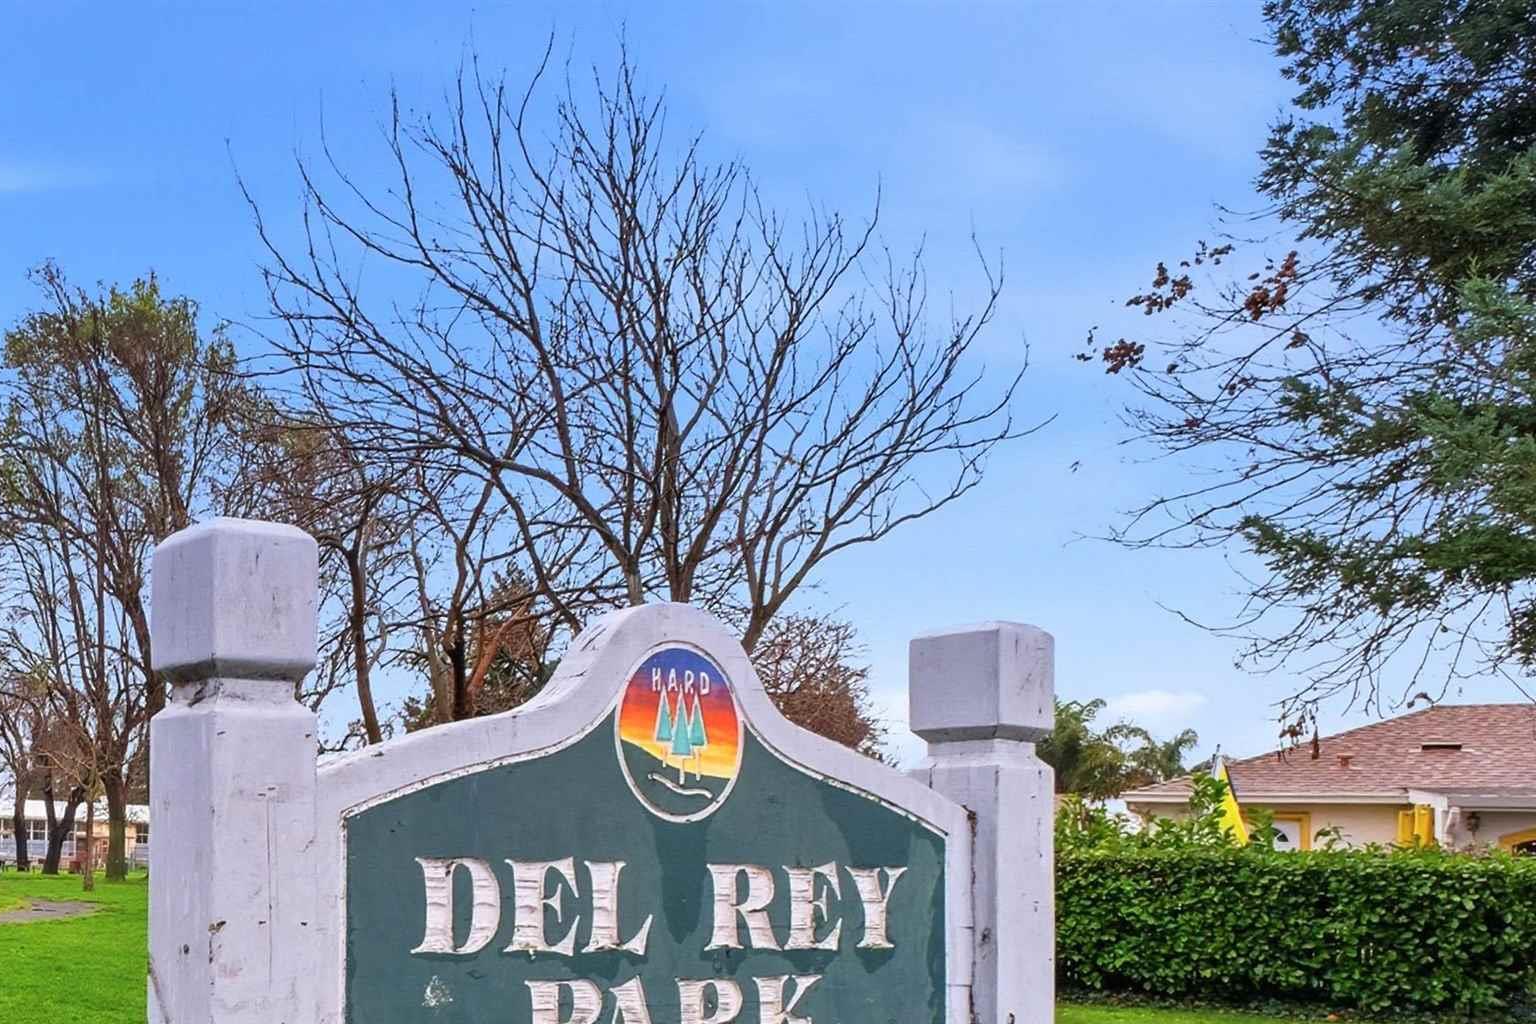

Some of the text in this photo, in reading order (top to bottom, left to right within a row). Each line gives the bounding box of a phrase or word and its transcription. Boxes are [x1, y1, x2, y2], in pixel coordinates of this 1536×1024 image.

[651, 667, 711, 695] HARD
[410, 856, 908, 956] DEL REY
